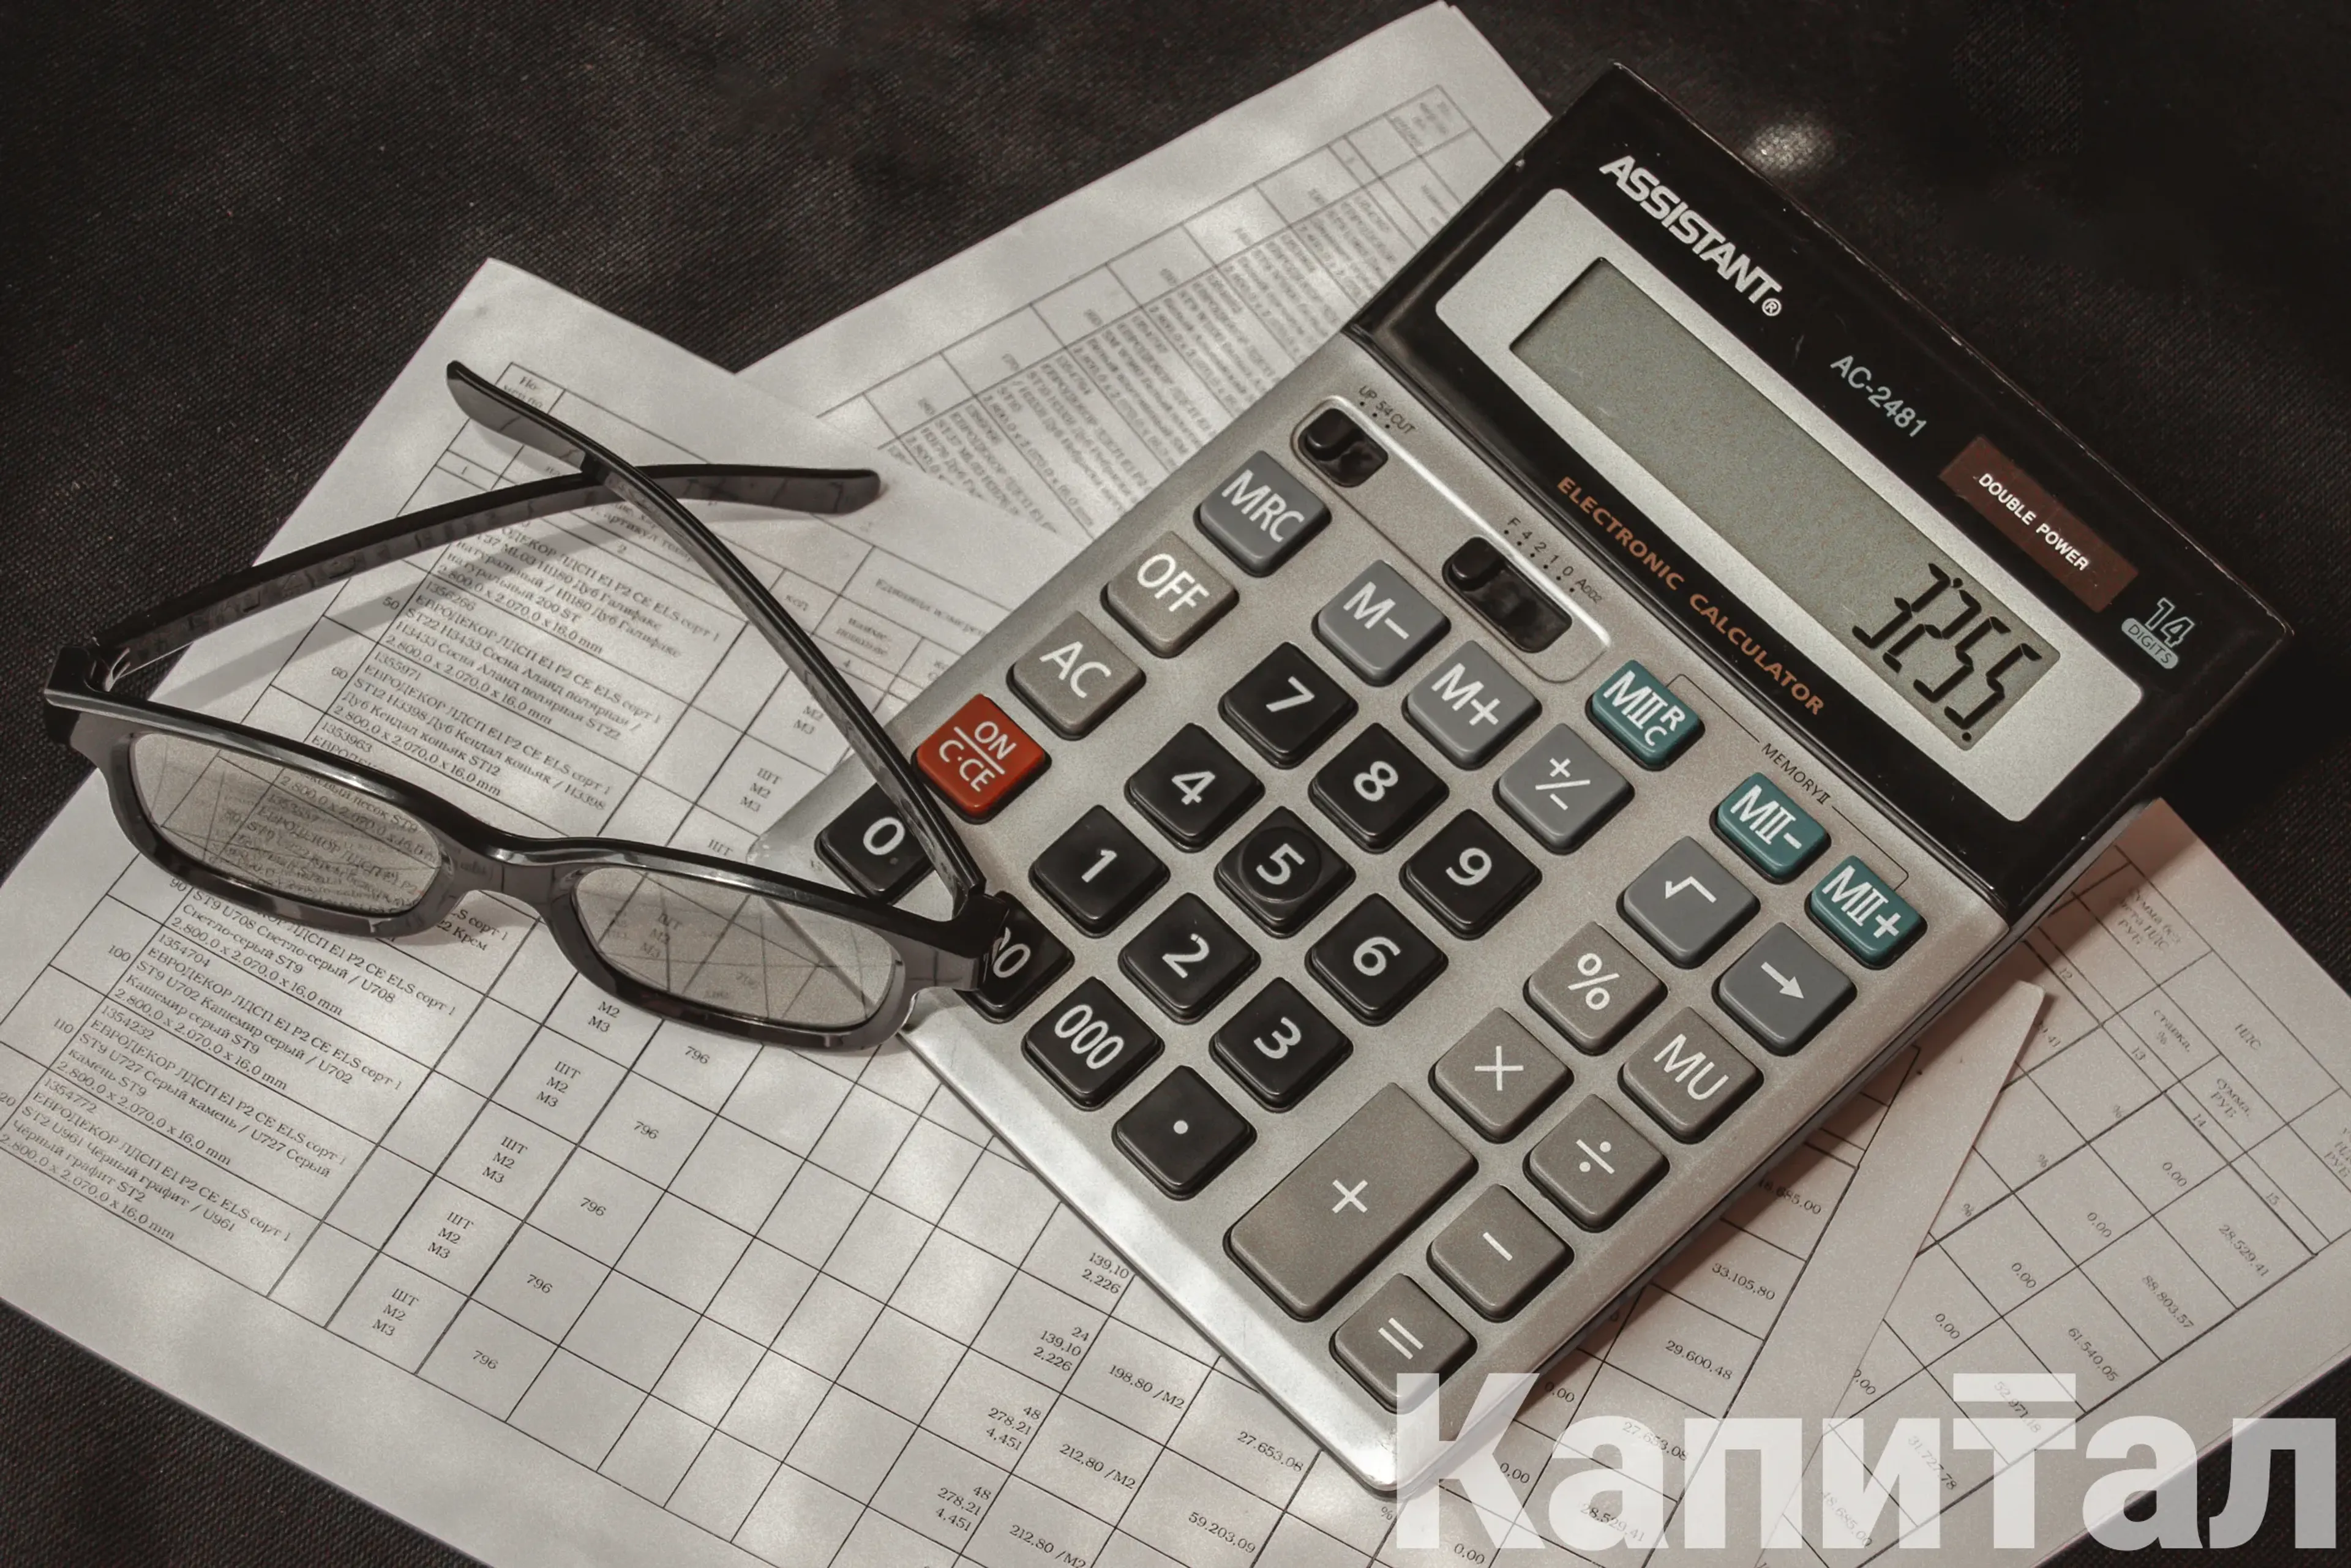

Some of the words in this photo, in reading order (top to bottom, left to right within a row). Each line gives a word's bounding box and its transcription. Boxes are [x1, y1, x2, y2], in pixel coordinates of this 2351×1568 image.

[1358, 384, 1378, 401] UP
[1389, 411, 1417, 435] CUT
[1830, 356, 1927, 437] AC-2481
[1221, 469, 1306, 543] MRC
[1978, 473, 2037, 526] DOUBLE
[2036, 523, 2090, 571] POWER
[1507, 517, 1521, 533] F
[1521, 530, 1533, 540] 4
[1534, 542, 1547, 554] 2
[1549, 554, 1559, 564] 1
[1136, 553, 1210, 614] OFF
[1556, 476, 1685, 591] ELECTRONIC
[1689, 593, 1824, 715] CALCULATOR
[2128, 623, 2173, 665] DIGITS
[2145, 597, 2195, 648] 14
[1039, 641, 1112, 699] AC
[1266, 677, 1316, 713] 7
[1431, 662, 1499, 727] M+
[974, 720, 1017, 761] ON
[1171, 770, 1217, 805] 4
[1353, 760, 1400, 802] 8
[863, 816, 906, 856] 0
[1081, 849, 1117, 883] 1
[1256, 842, 1306, 886] 5
[1445, 847, 1493, 887] 9
[1161, 932, 1210, 978] 2
[1353, 936, 1401, 977] 6
[1567, 953, 1620, 1011] %
[1053, 1003, 1125, 1070] 000
[1253, 1016, 1303, 1059] 3
[1653, 1033, 1730, 1101] MU
[1070, 1326, 1090, 1342] 24
[1022, 1406, 1042, 1420] 48
